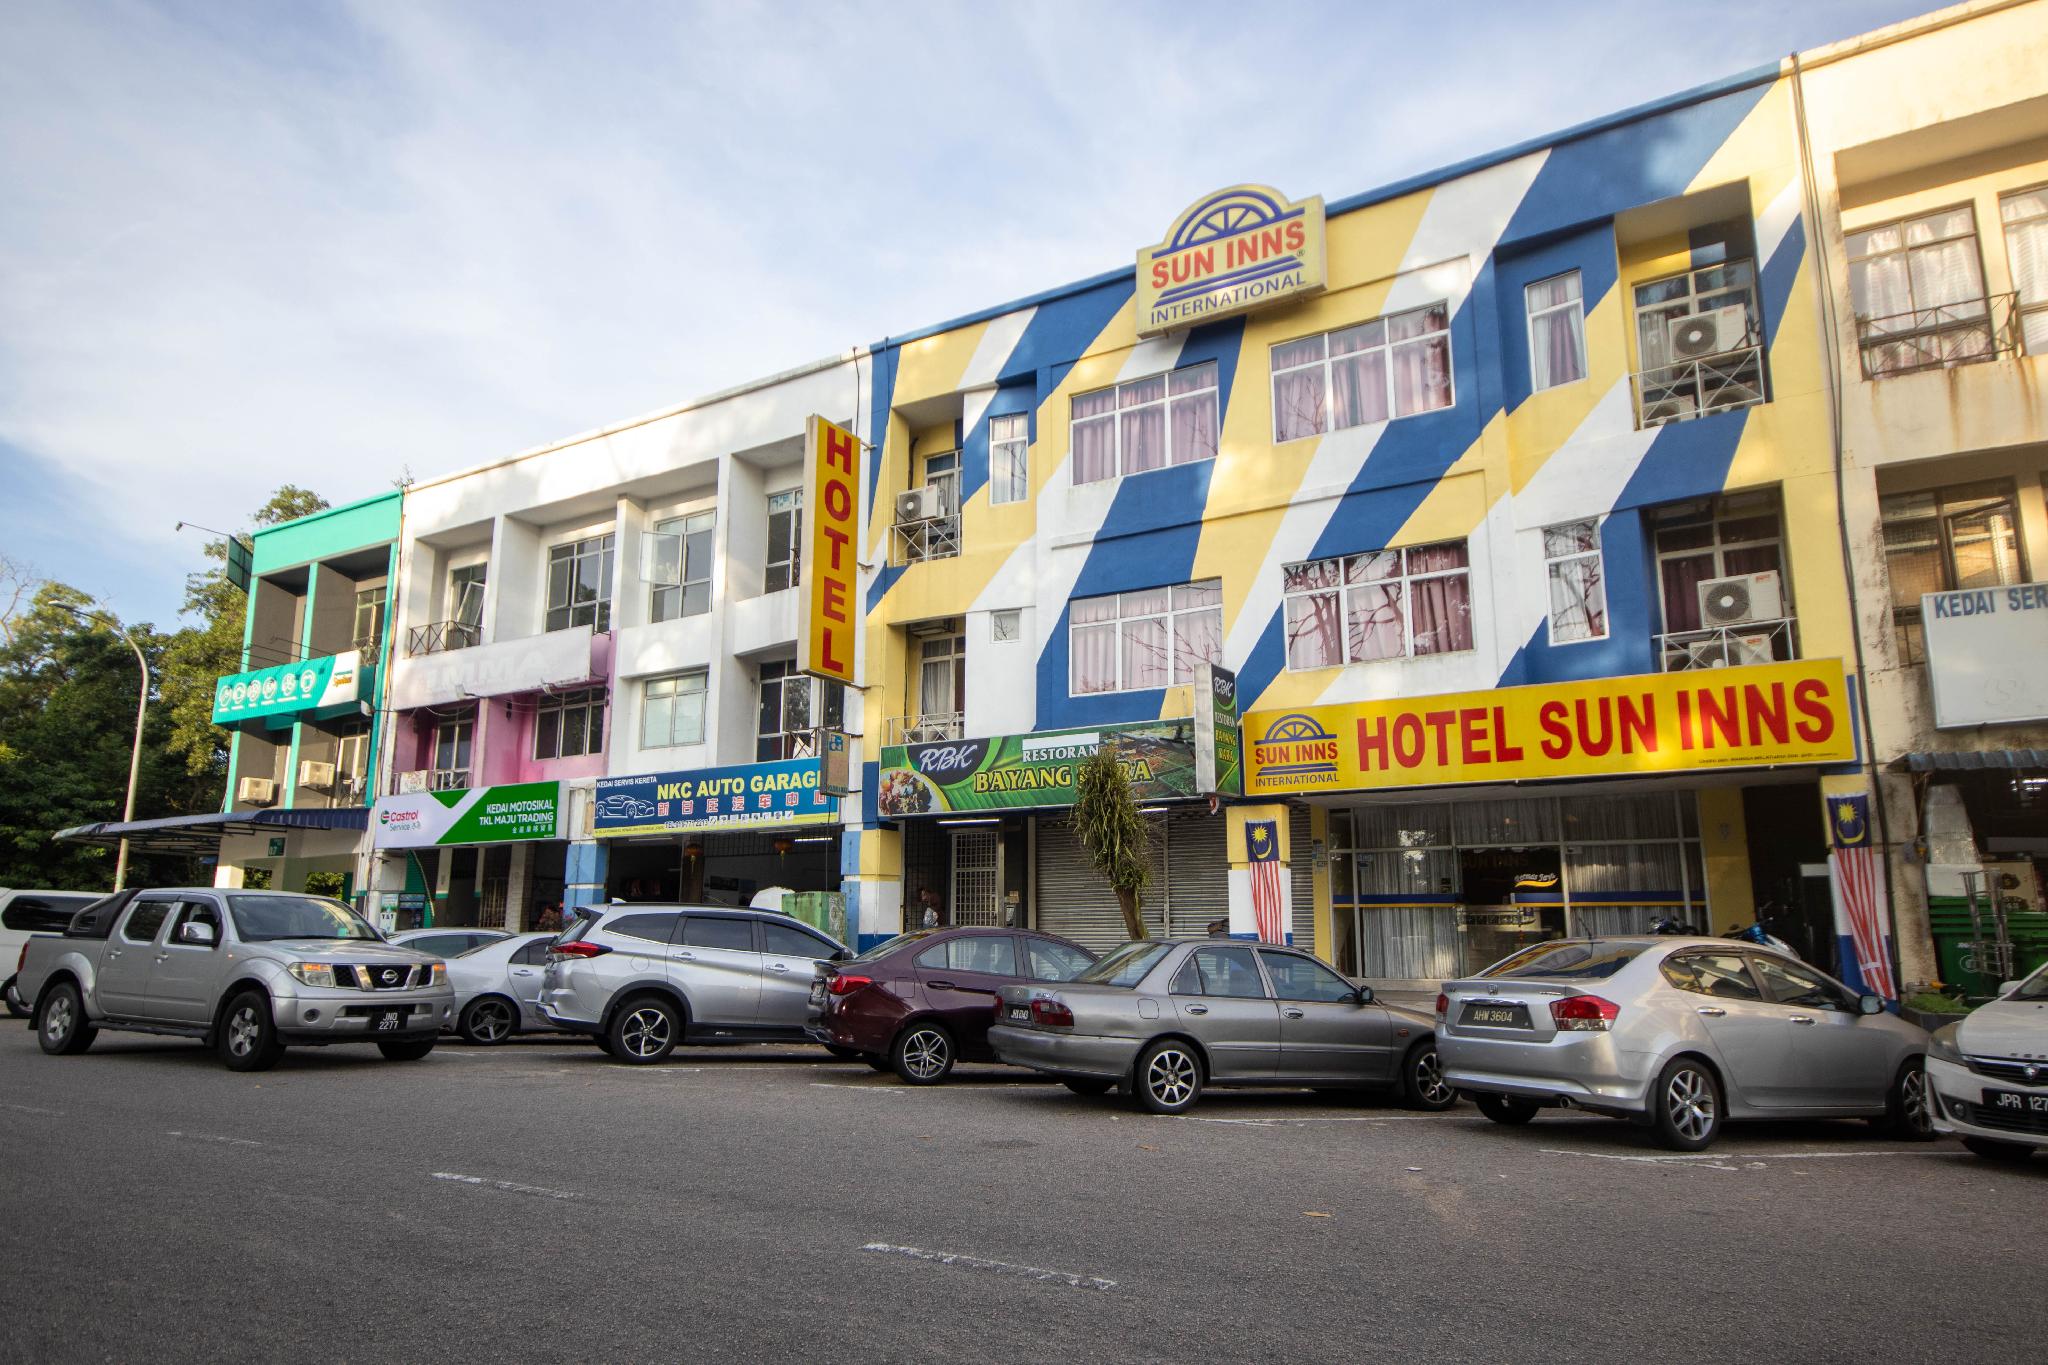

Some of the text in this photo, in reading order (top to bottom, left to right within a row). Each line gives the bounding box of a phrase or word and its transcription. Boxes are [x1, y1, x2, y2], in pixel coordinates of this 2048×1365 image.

[1152, 221, 1306, 289] SUN INNS
[1151, 270, 1307, 325] INTERNATIONAL
[821, 426, 852, 673] HOTEL
[1934, 590, 1996, 619] KEDAI
[1214, 676, 1234, 697] RBK
[1356, 678, 1835, 771] HOTEL SUN INNS
[919, 744, 978, 772] RBK
[1022, 744, 1100, 763] RESTORAN
[1255, 742, 1339, 765] SUN INNS
[596, 776, 657, 788] KEDAI SERVIS KERETA
[656, 781, 692, 800] NKC
[696, 777, 745, 797] AUTO
[974, 765, 1073, 793] BAYANG
[1255, 773, 1340, 787] INTERNATIONAL
[390, 809, 419, 822] Castrol
[486, 799, 555, 814] KEDAI MOTOSIKAL
[479, 811, 554, 826] TKL MAJU TRADING
[379, 1020, 399, 1030] 2277
[1473, 1009, 1513, 1022] AHW 3604
[1996, 1093, 2022, 1109] JPR
